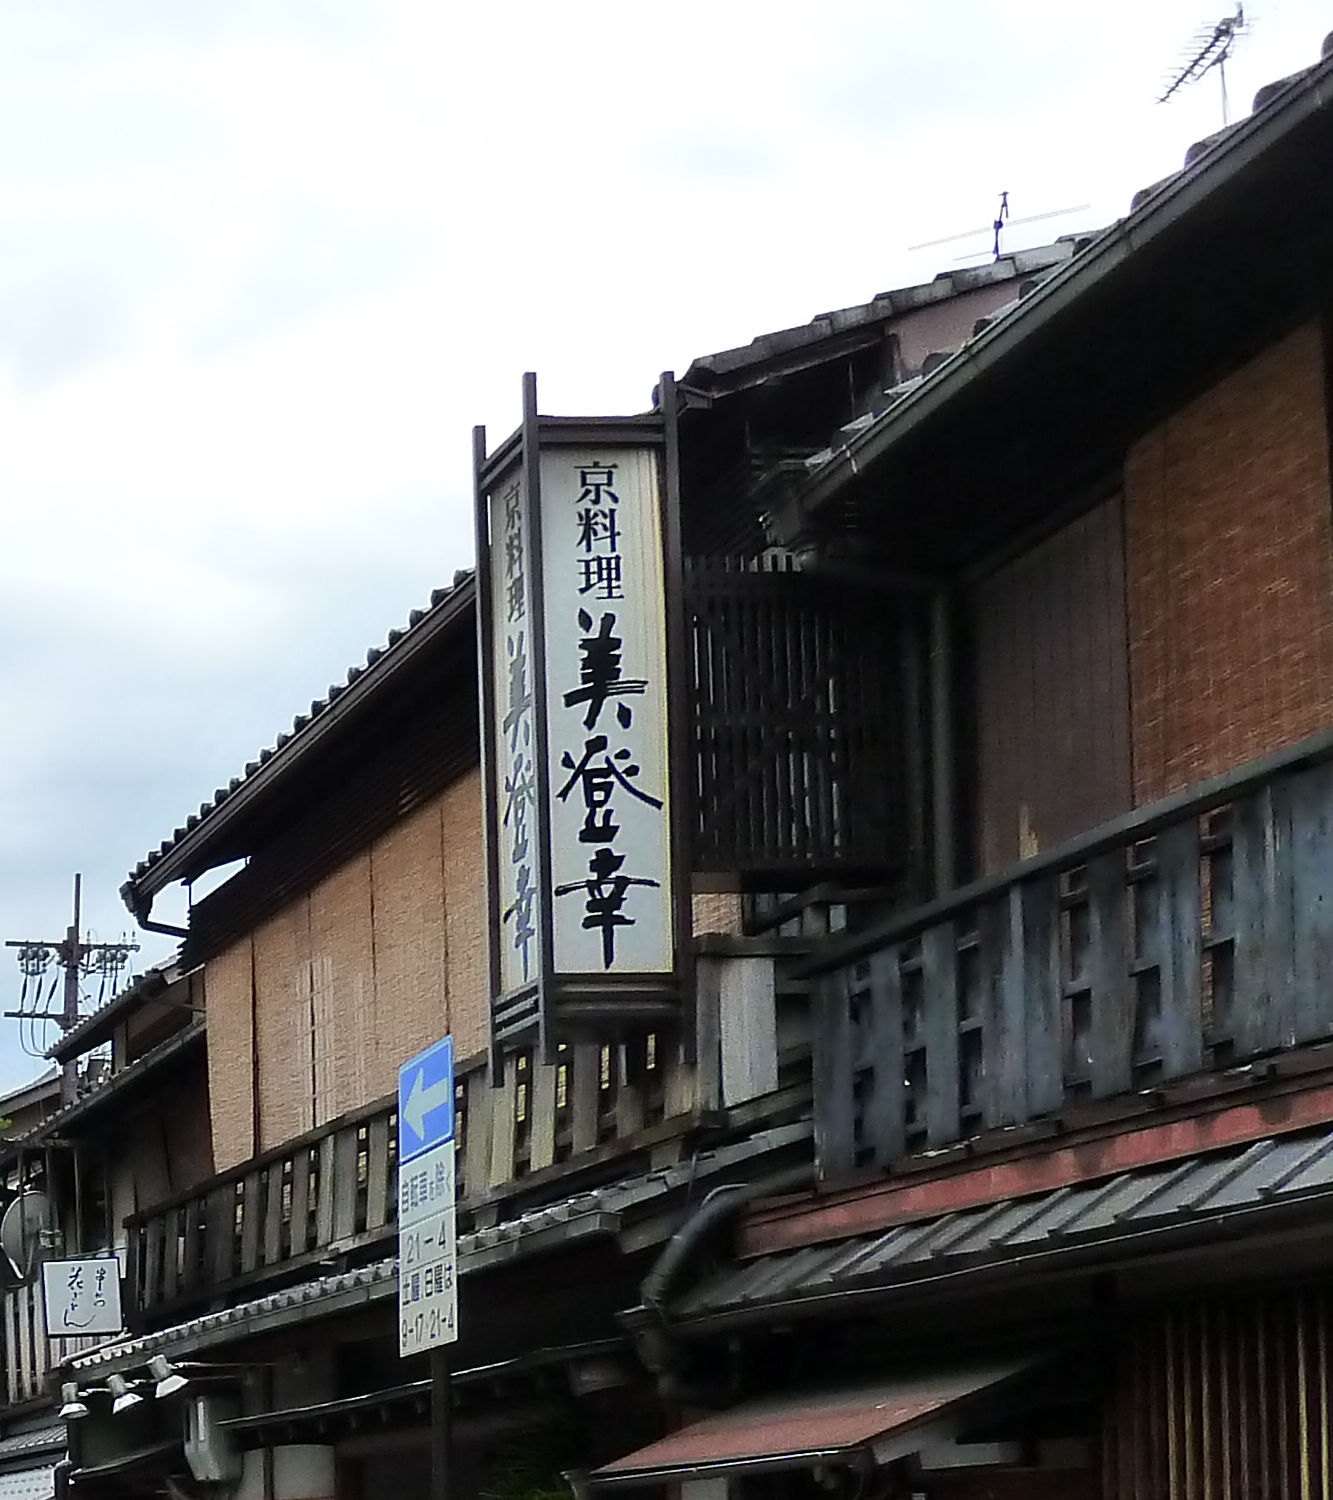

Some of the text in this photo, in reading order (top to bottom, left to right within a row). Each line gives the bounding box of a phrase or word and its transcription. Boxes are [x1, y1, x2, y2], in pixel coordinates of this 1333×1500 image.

[504, 481, 526, 623] 京料理
[573, 461, 625, 600] 京料理
[503, 630, 537, 982] 美登幸
[555, 608, 664, 970] 美登幸
[402, 1161, 452, 1213] 自転車を除く
